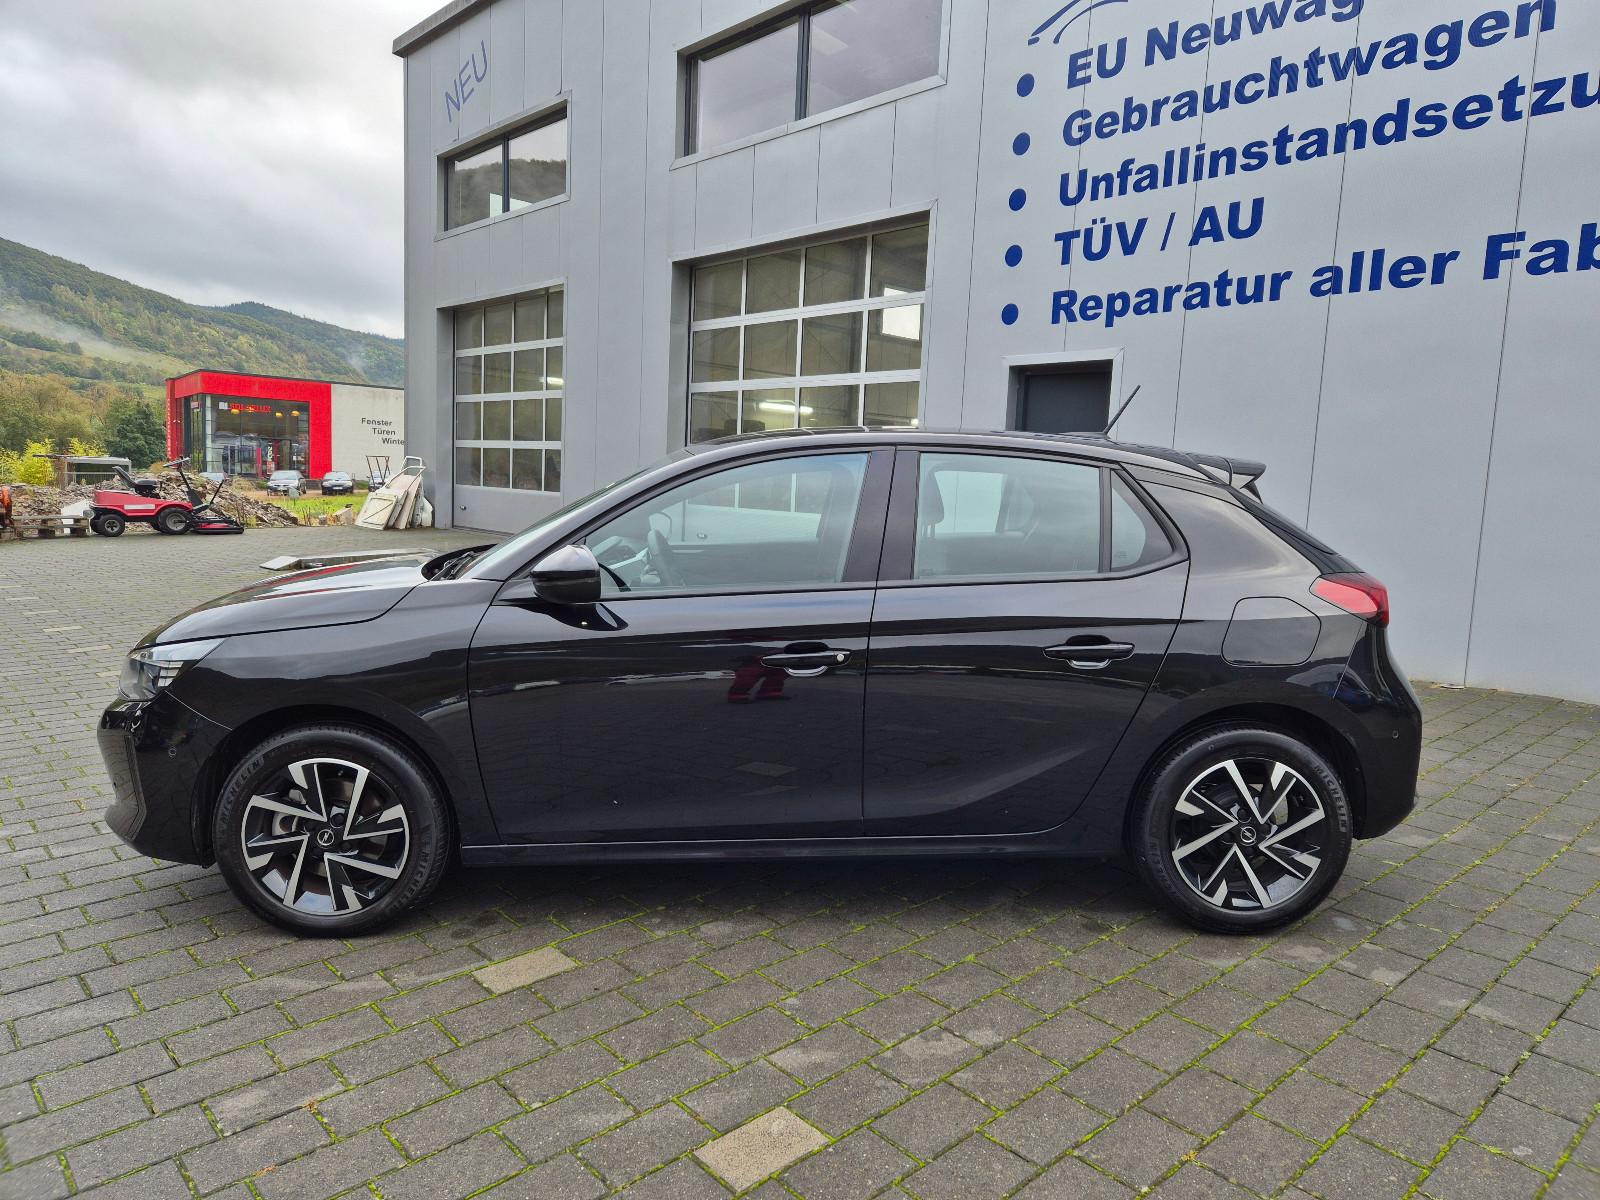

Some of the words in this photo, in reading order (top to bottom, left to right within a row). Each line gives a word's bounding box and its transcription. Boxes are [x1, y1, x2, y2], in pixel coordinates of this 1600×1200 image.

[445, 40, 488, 122] NEU
[1063, 0, 1557, 147] Gebrauchtwagen
[1067, 38, 1127, 88] EU
[1059, 72, 1600, 206] Unfallinstandsetzu
[1055, 217, 1148, 266] TÜV
[1160, 213, 1175, 251] /
[1189, 198, 1264, 247] AU
[1050, 271, 1294, 329] Reparatur
[1310, 249, 1460, 297] aller
[361, 417, 393, 426] Fenster
[372, 427, 396, 436] Türen
[221, 758, 261, 826] MICHELIN
[1313, 764, 1348, 828] MICHELIN
